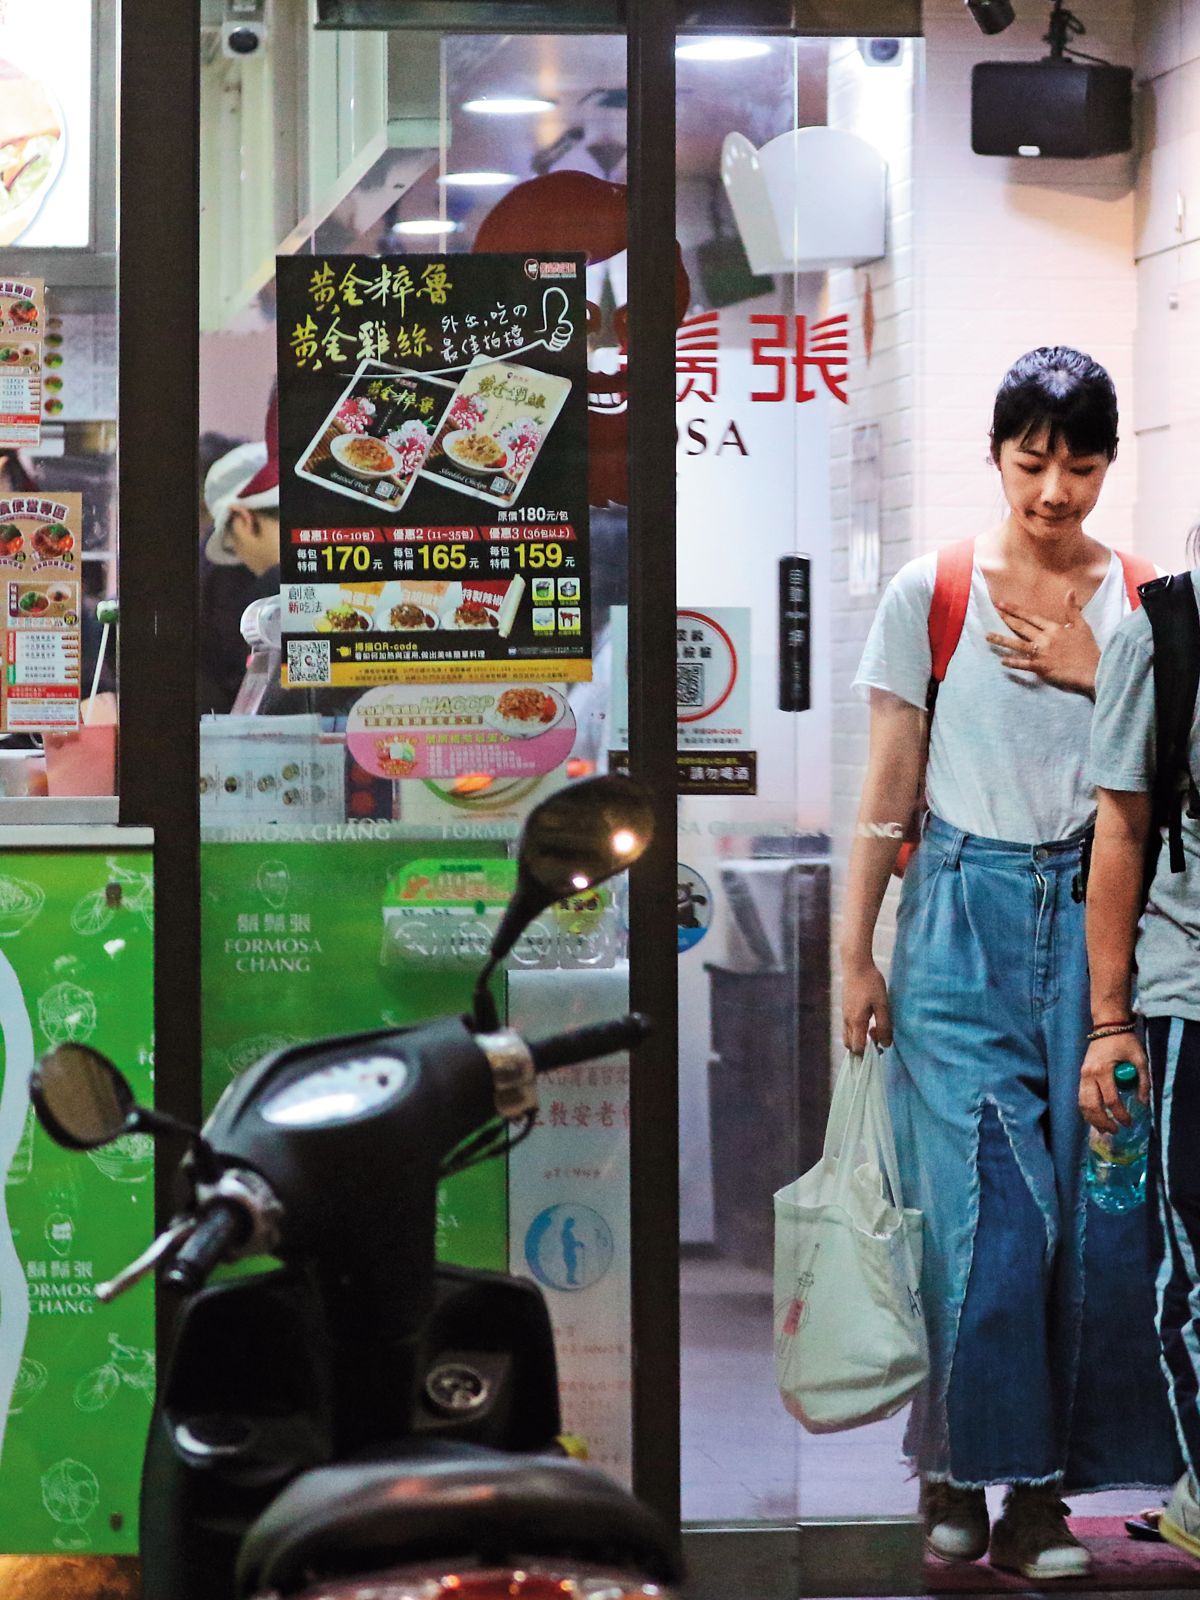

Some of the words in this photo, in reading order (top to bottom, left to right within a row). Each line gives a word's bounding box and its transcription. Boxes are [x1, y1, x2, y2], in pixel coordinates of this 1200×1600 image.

[498, 506, 569, 522] 原價180元/包
[300, 529, 328, 542] 優惠1
[393, 528, 424, 541] 優惠2
[489, 526, 519, 540] 優惠3
[297, 549, 317, 560] 每包
[393, 547, 413, 558] 每包
[490, 546, 510, 557] 每包
[297, 561, 317, 572] 特價
[393, 559, 413, 571] 特價
[489, 558, 510, 569] 特價
[288, 585, 316, 600] 創意
[288, 601, 322, 614] 新吃法
[312, 824, 391, 841] CHANG
[224, 938, 322, 953] FORMOSA
[236, 957, 310, 972] CHANG
